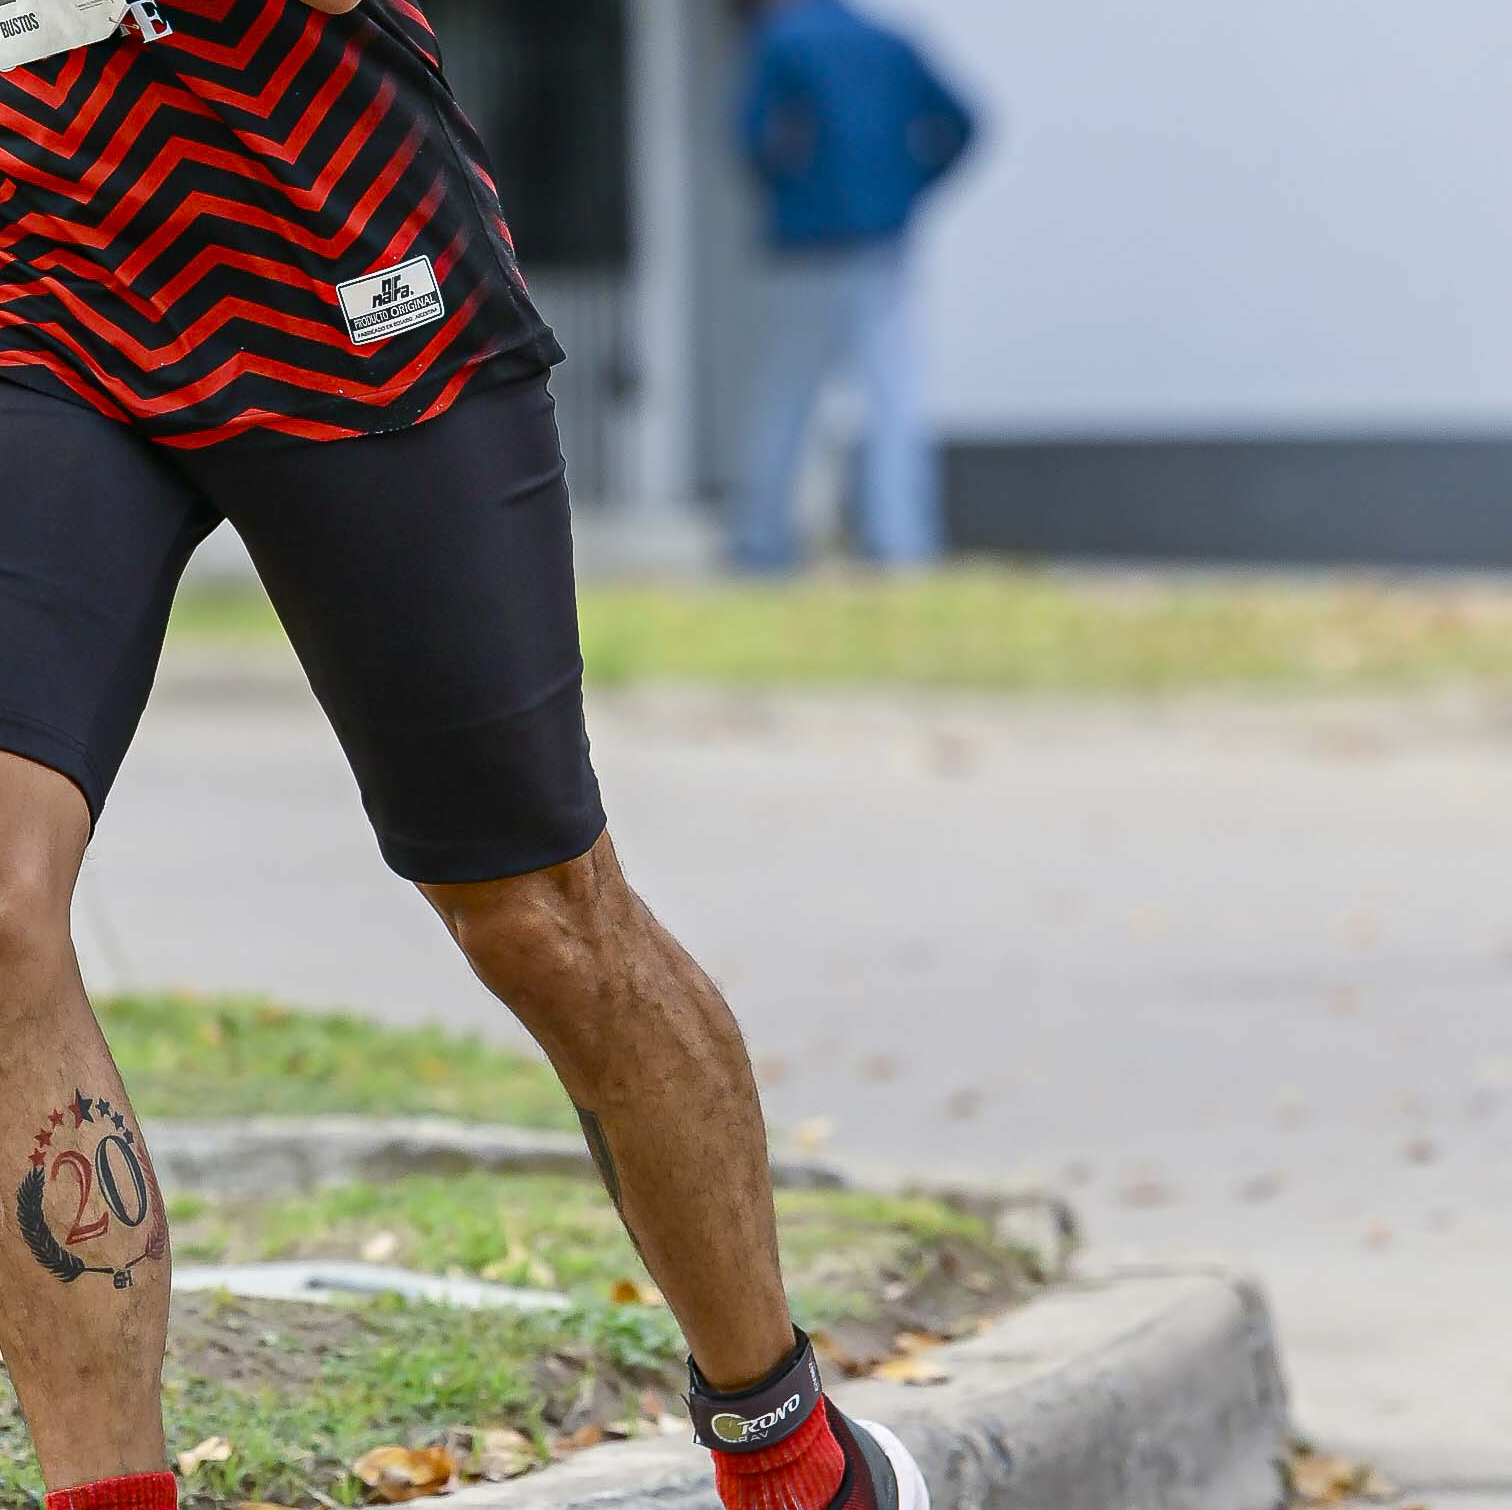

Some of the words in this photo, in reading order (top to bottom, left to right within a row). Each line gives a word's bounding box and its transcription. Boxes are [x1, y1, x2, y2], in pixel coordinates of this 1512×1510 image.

[0, 12, 40, 39] BUSTOS
[354, 311, 389, 330] PRODUCTO
[390, 293, 437, 317] ORIGINAL
[50, 1134, 148, 1246] 20
